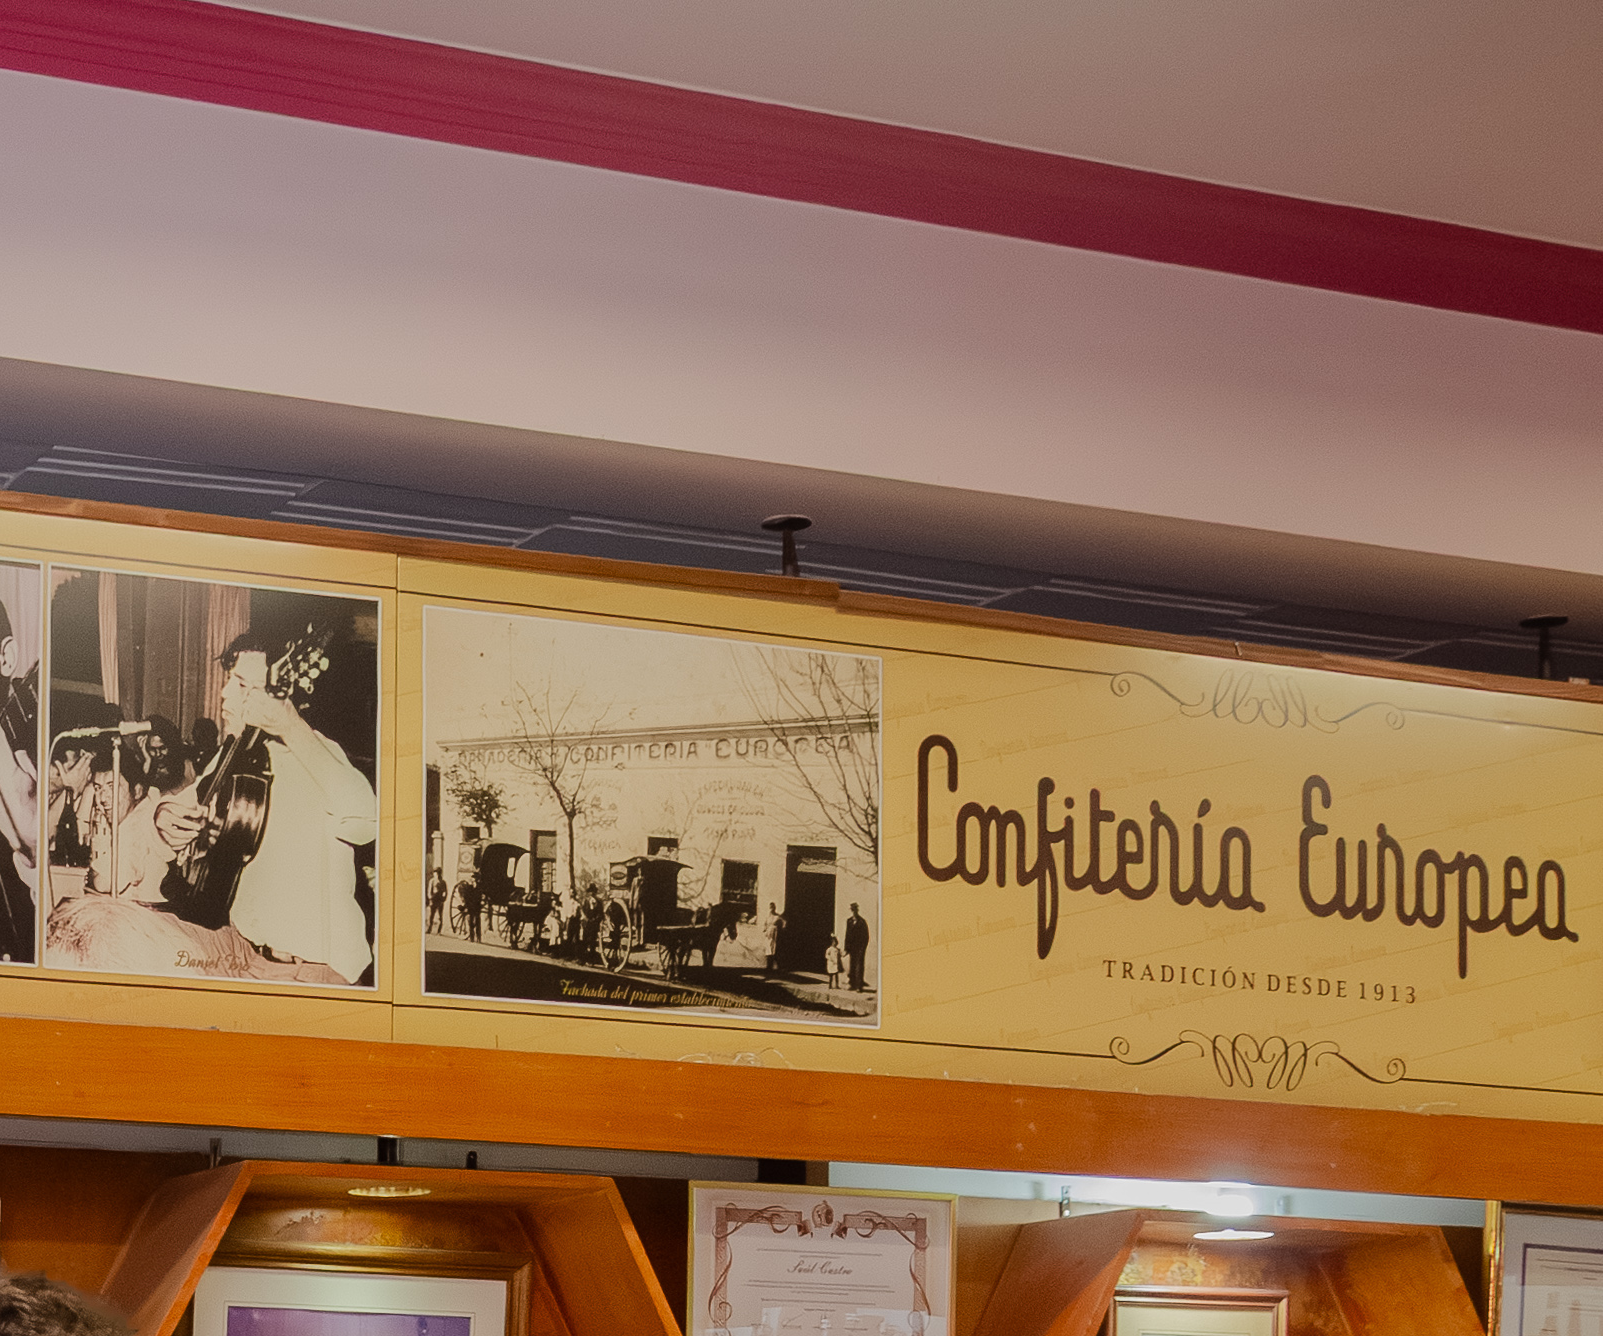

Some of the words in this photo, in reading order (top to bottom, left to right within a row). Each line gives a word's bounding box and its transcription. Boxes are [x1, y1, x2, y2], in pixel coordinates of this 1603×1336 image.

[917, 734, 1266, 959] Confitería
[1298, 775, 1579, 979] Europea
[174, 950, 220, 970] Daniel
[610, 985, 630, 1000] del
[629, 989, 667, 1005] primer
[1103, 958, 1256, 991] TRADICIÓN
[1266, 972, 1349, 999] DESDE
[1358, 980, 1418, 1005] 1913
